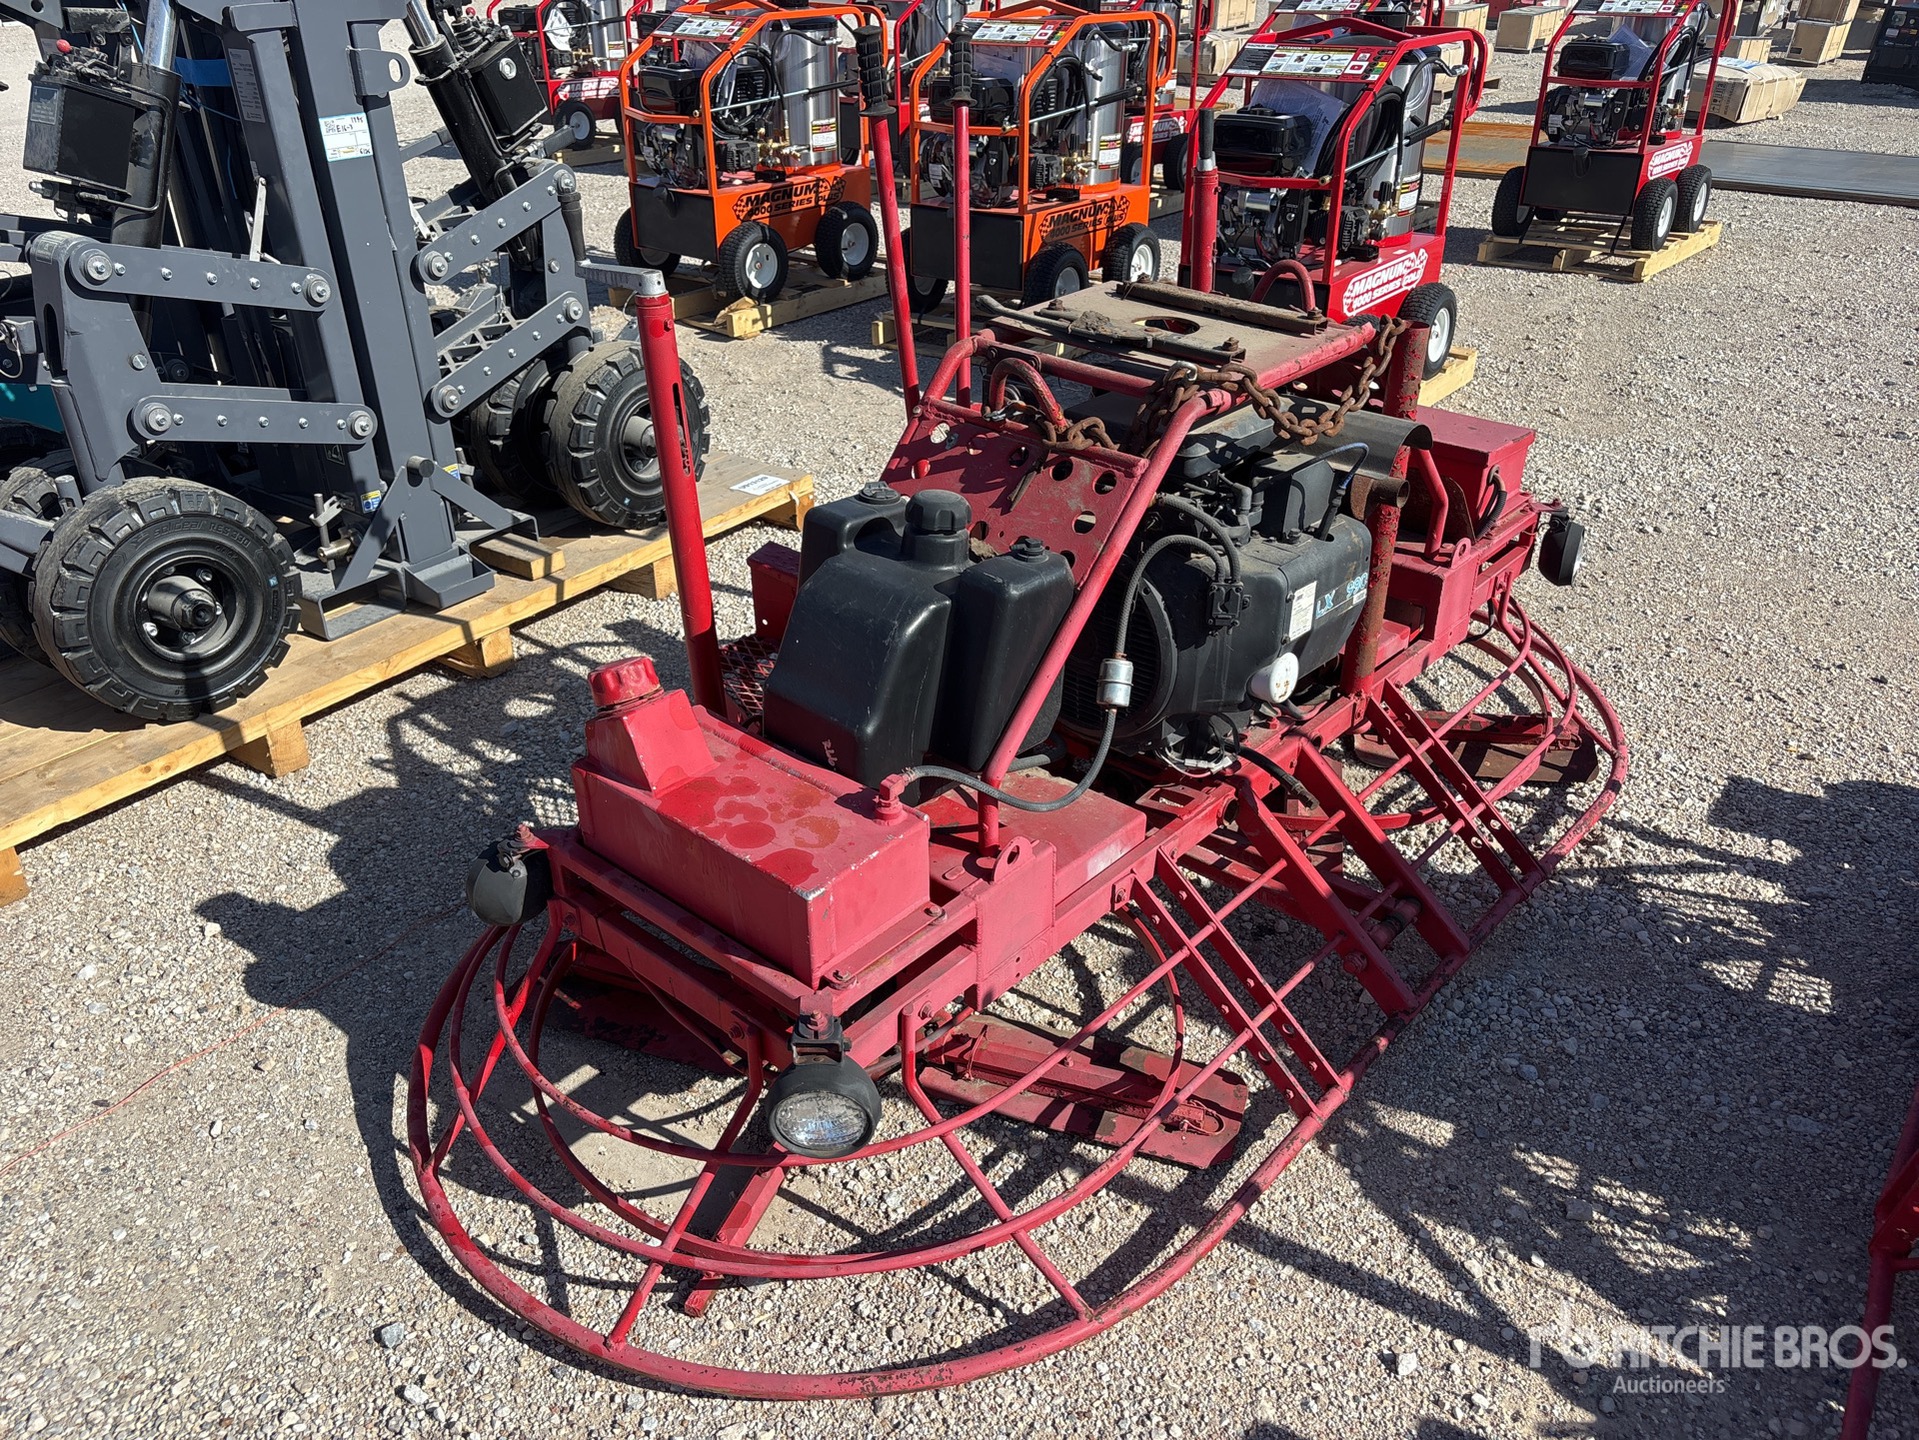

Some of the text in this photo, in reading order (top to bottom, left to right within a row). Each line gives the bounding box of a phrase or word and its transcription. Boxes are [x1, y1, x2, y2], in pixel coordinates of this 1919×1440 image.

[745, 182, 820, 207] MAGNUM
[774, 196, 813, 212] SERIES
[1049, 204, 1110, 227] MAGNUM
[1071, 217, 1103, 231] SERIES
[1353, 261, 1409, 296] MAGNUM
[1373, 278, 1402, 300] SERIES
[1315, 589, 1336, 619] LX
